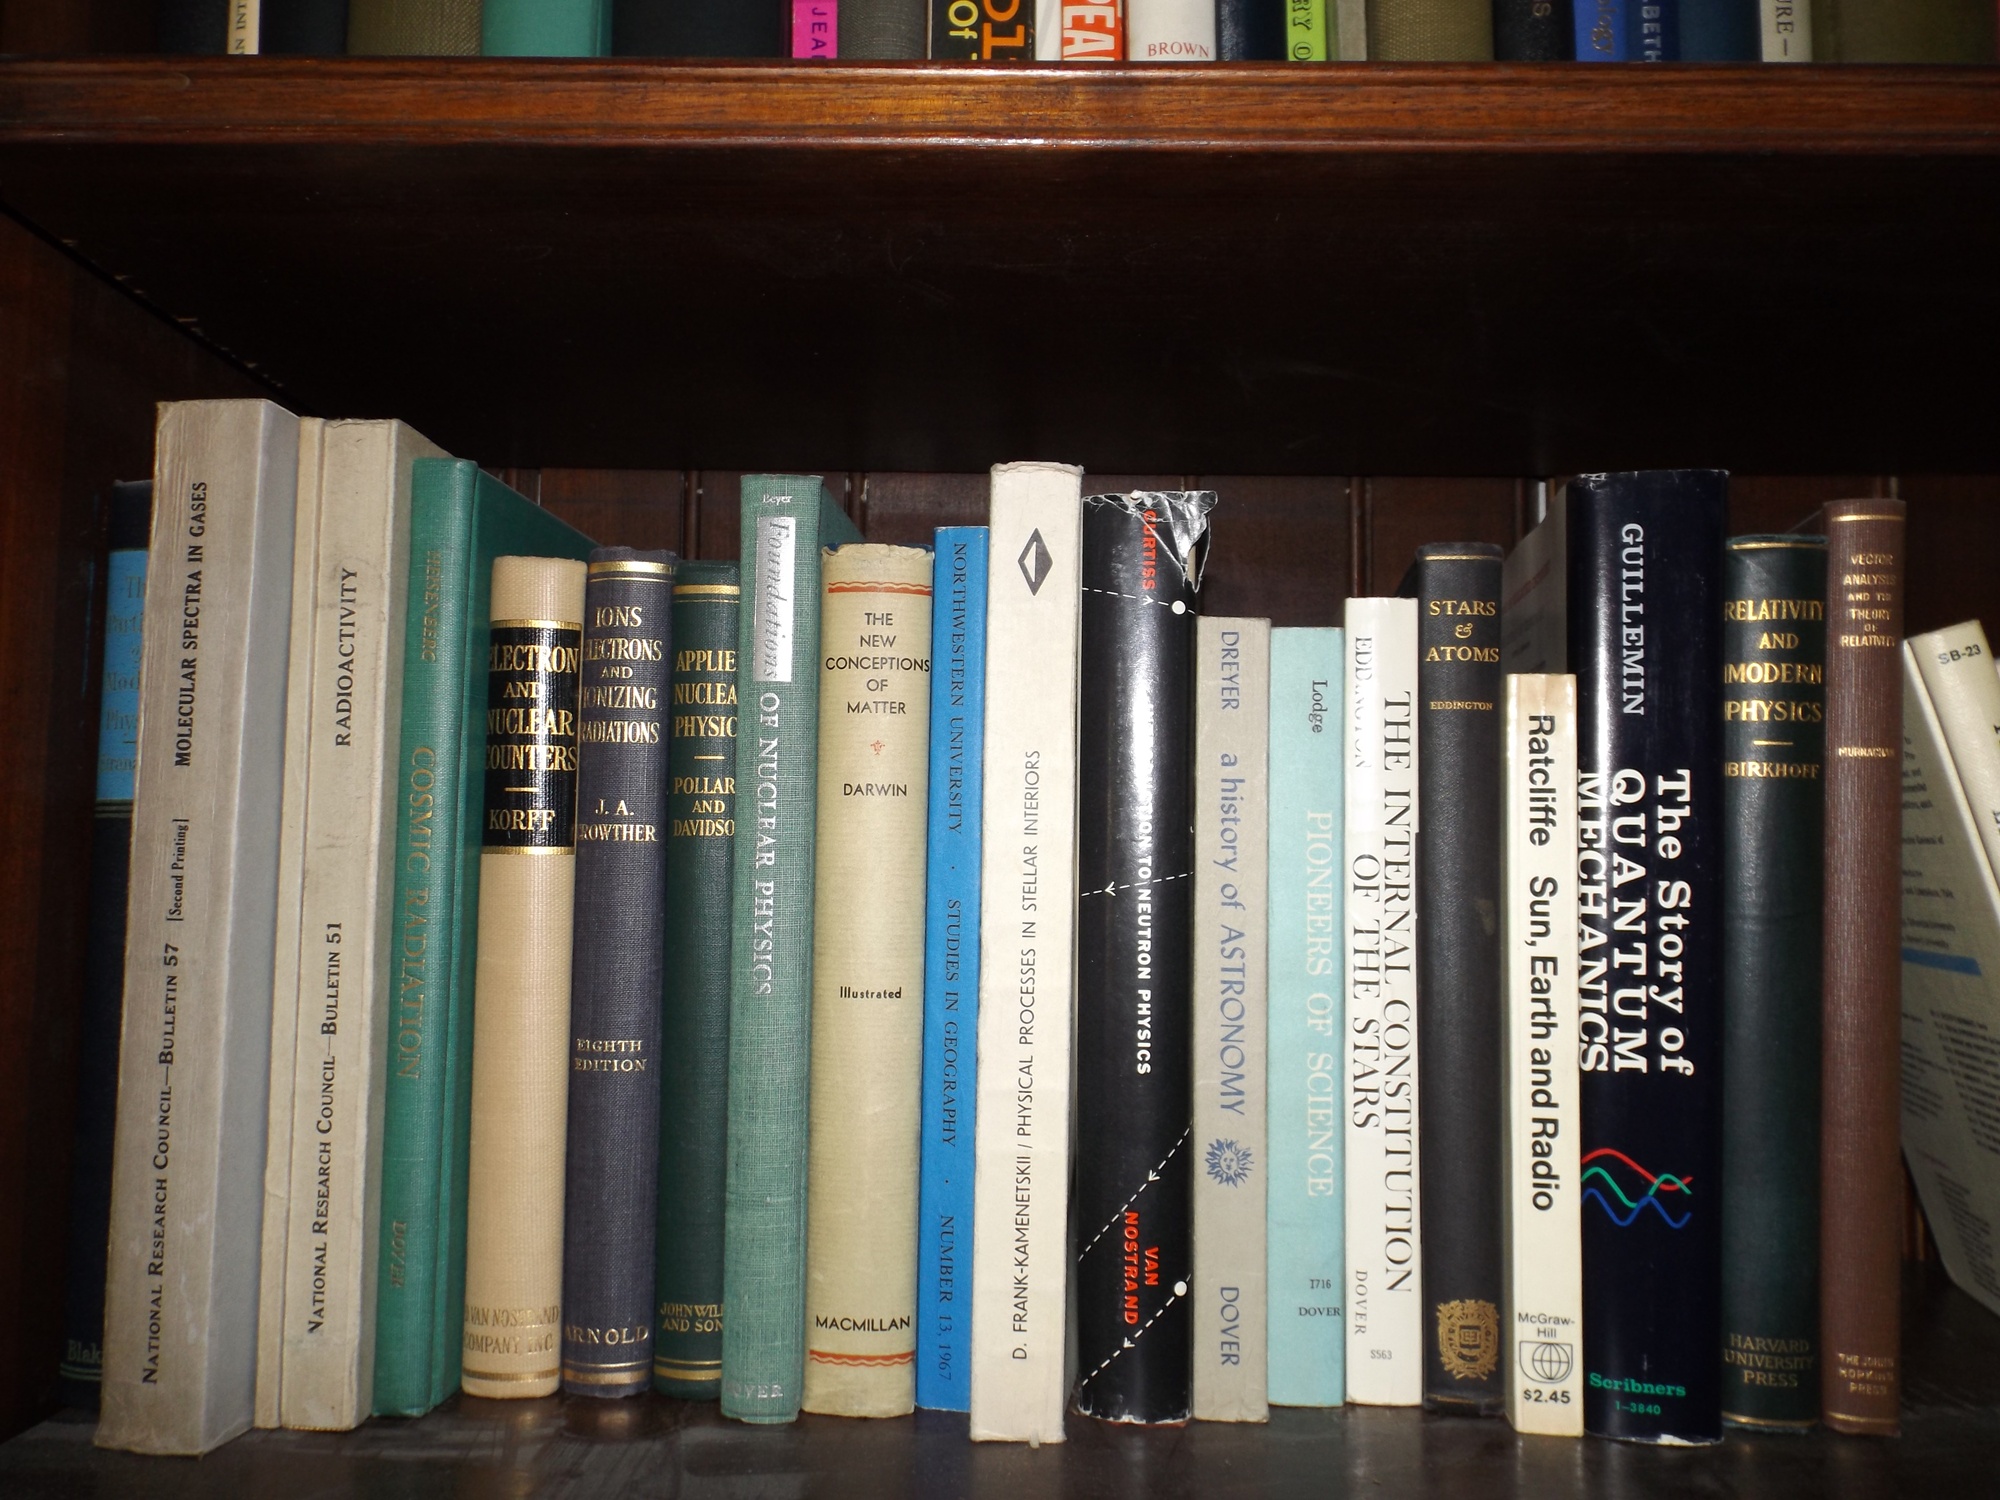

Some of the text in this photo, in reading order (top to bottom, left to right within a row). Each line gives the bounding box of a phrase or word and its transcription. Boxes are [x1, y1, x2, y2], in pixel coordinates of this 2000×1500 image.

[948, 0, 979, 39] Of
[1147, 42, 1210, 58] BROWN
[1142, 509, 1157, 590] CURTISS
[1851, 553, 1893, 565] VECTOR
[595, 606, 642, 628] IONS
[864, 612, 894, 626] THE
[1429, 600, 1496, 617] STARS
[1621, 522, 1645, 717] GUILLEMIN
[1725, 600, 1824, 621] RELATIVITY
[174, 481, 208, 767] MOLECULAR SPECTRA IN GASES
[950, 542, 967, 708] NORTHWESTERN
[1455, 623, 1472, 638] &
[584, 638, 662, 661] ELECTRONS
[860, 634, 897, 648] NEW
[1759, 632, 1799, 649] AND
[335, 567, 358, 747] RADIOACTIVITY
[488, 643, 579, 673] ELECTRON
[676, 650, 738, 672] APPLIE
[825, 657, 930, 672] CONCEPTIONS
[1425, 646, 1500, 663] ATOMS
[1937, 643, 1983, 666] SB-23
[601, 666, 633, 679] AND
[1725, 662, 1821, 684] MODERN
[503, 682, 545, 699] AND
[673, 683, 737, 705] NUCLEA
[866, 678, 889, 693] OF
[582, 686, 657, 710] IONIZING
[847, 701, 907, 715] MATTER
[1308, 680, 1328, 733] Lodge
[1430, 701, 1493, 711] EDDINGTON
[1725, 700, 1822, 722] PHYSICS
[486, 708, 575, 737] NUCLEAR
[580, 721, 660, 744] RADIATIONS
[674, 716, 737, 737] PHYSIC
[484, 744, 577, 771] COUNTERS
[753, 521, 791, 997] Foundations OF NUCLEAR PHYSICS
[946, 716, 965, 836] UNIVERSITY
[1725, 761, 1819, 778] BIRKHOFF
[673, 777, 735, 795] POLLAR
[843, 783, 908, 797] DARWIN
[595, 799, 635, 817] J. A.
[692, 800, 725, 814] AND
[489, 809, 556, 831] KORFF
[673, 818, 735, 837] DAVIDSO
[1213, 631, 1246, 1116] DREYER a history of ASTRONOMY
[397, 746, 437, 1079] COSMIC RADIATION
[1577, 769, 1608, 1072] MECHANICS
[1610, 769, 1647, 1073] QUANTUM
[1650, 769, 1694, 1076] The Story of
[327, 921, 342, 942] 51
[943, 899, 962, 982] STUDIES
[1137, 883, 1152, 979] NEUTRON
[164, 943, 178, 967] 57
[1525, 714, 1559, 1211] Ratcliffe Sun, Earth and Radio
[839, 987, 902, 1000] Illustrated
[944, 990, 958, 1012] IN
[1352, 854, 1381, 1129] OF THE STARS
[1383, 690, 1413, 1294] THE INTERNAL CONSTITUTION
[1306, 810, 1333, 1198] PIONEERS OF SCIENCE
[1137, 989, 1151, 1075] PHYSICS
[576, 1038, 643, 1052] EIGHTH
[1012, 750, 1040, 1361] D. FRANK-KAMENETSKII PHYSICAL PROCESSES IN STELLAR INTERIORS
[574, 1058, 647, 1073] EDITION
[941, 1021, 958, 1148] GEOGRAPHY
[313, 1140, 330, 1237] RESEARCH
[149, 1176, 167, 1276] RESEARCH
[938, 1214, 956, 1304] NUMBER
[1123, 1211, 1138, 1325] NOSTRAND
[1145, 1247, 1158, 1285] VAN
[308, 1242, 326, 1334] NATIONAL
[660, 1302, 692, 1317] JOHN
[1299, 1306, 1341, 1317] DOVER
[1354, 1269, 1368, 1336] DOVER
[471, 1306, 489, 1325] VAN
[662, 1318, 690, 1332] AND
[815, 1315, 911, 1332] MACMILLAN
[1220, 1286, 1240, 1367] DOVER
[1518, 1312, 1575, 1326] McGraw-
[143, 1284, 163, 1385] NATIONAL
[1536, 1326, 1557, 1339] Hill
[1730, 1333, 1809, 1352] HARVARD
[1370, 1348, 1393, 1360] S563
[1724, 1349, 1813, 1370] UNIVERSITY
[1589, 1373, 1687, 1396] Scribners
[1744, 1370, 1798, 1386] PRESS
[1523, 1388, 1571, 1405] $2.45
